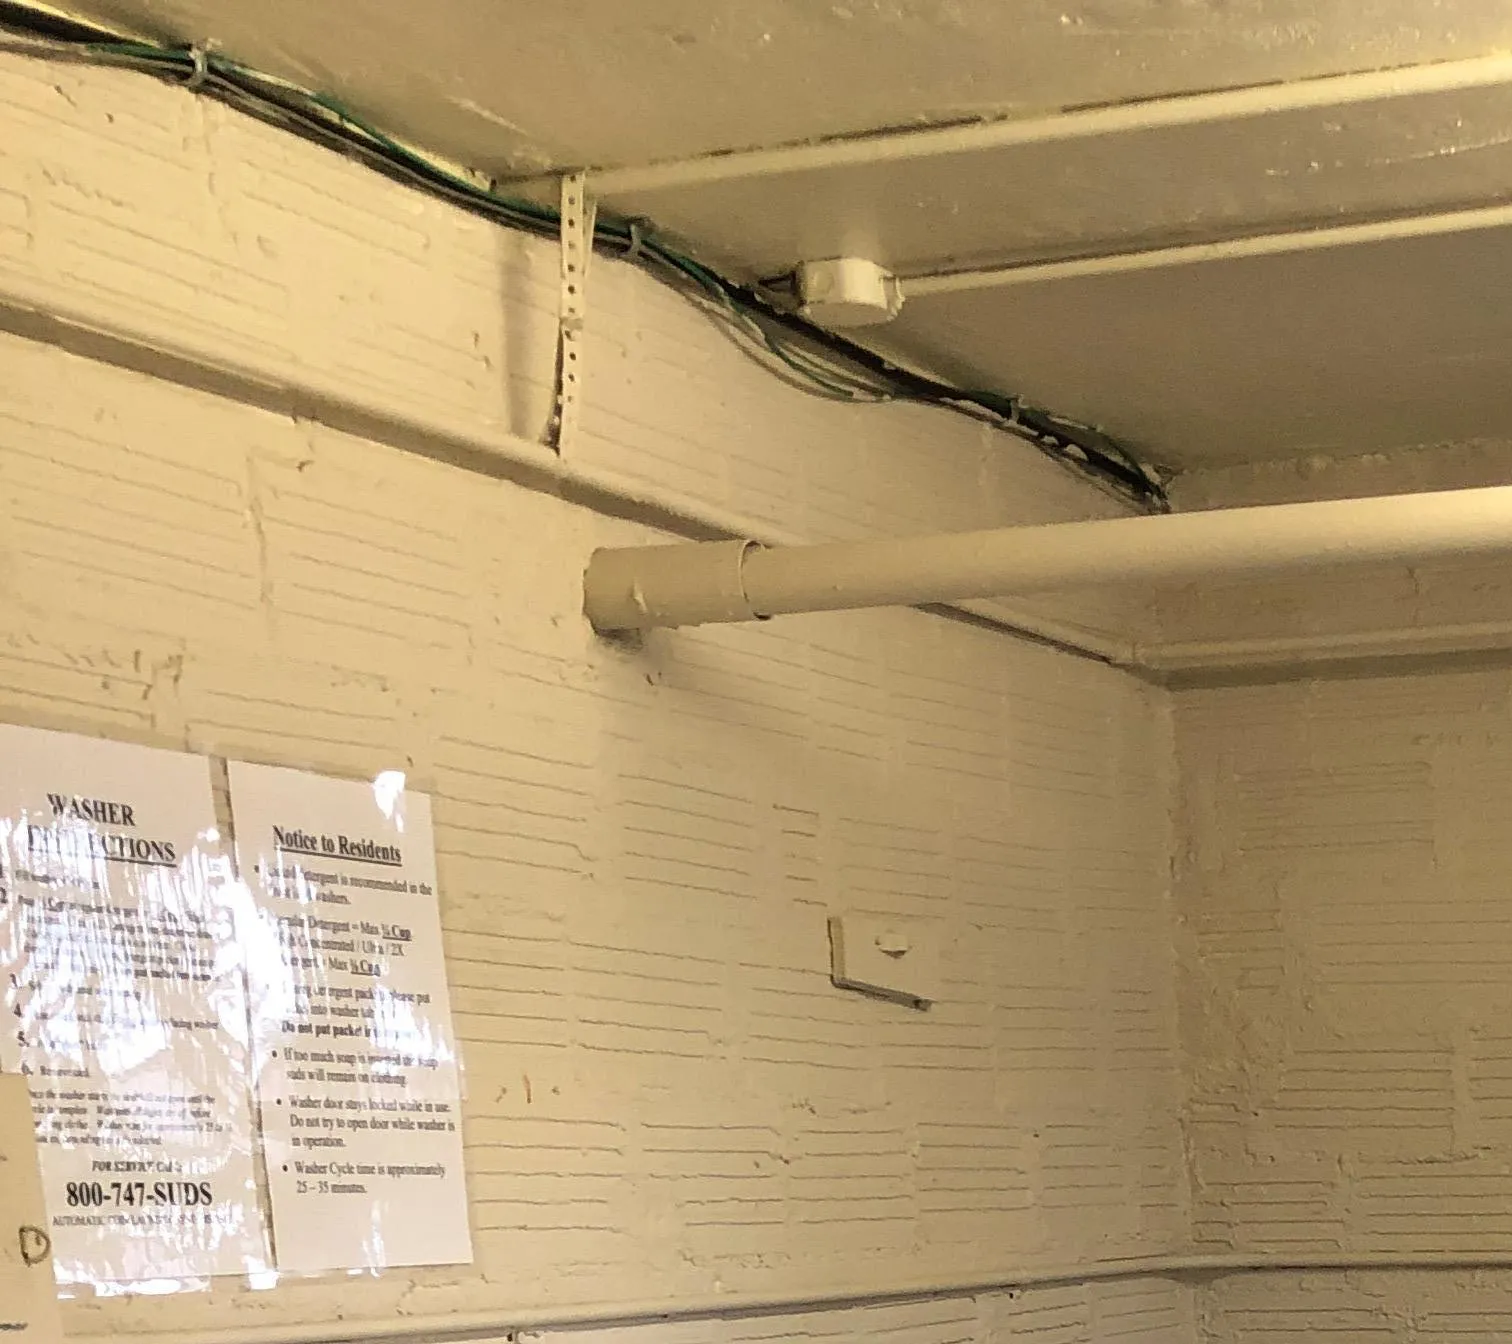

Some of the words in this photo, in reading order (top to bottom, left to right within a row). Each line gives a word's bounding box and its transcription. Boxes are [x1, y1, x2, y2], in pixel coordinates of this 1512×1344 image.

[47, 793, 136, 827] WASHER
[27, 825, 177, 862] ICTIONS
[273, 825, 318, 851] Notice
[321, 833, 336, 854] to
[338, 835, 403, 863] Residents
[303, 867, 339, 887] etergent
[290, 1113, 304, 1128] Do
[329, 1161, 355, 1178] Cycle
[66, 1181, 213, 1207] 800-747-SUDS
